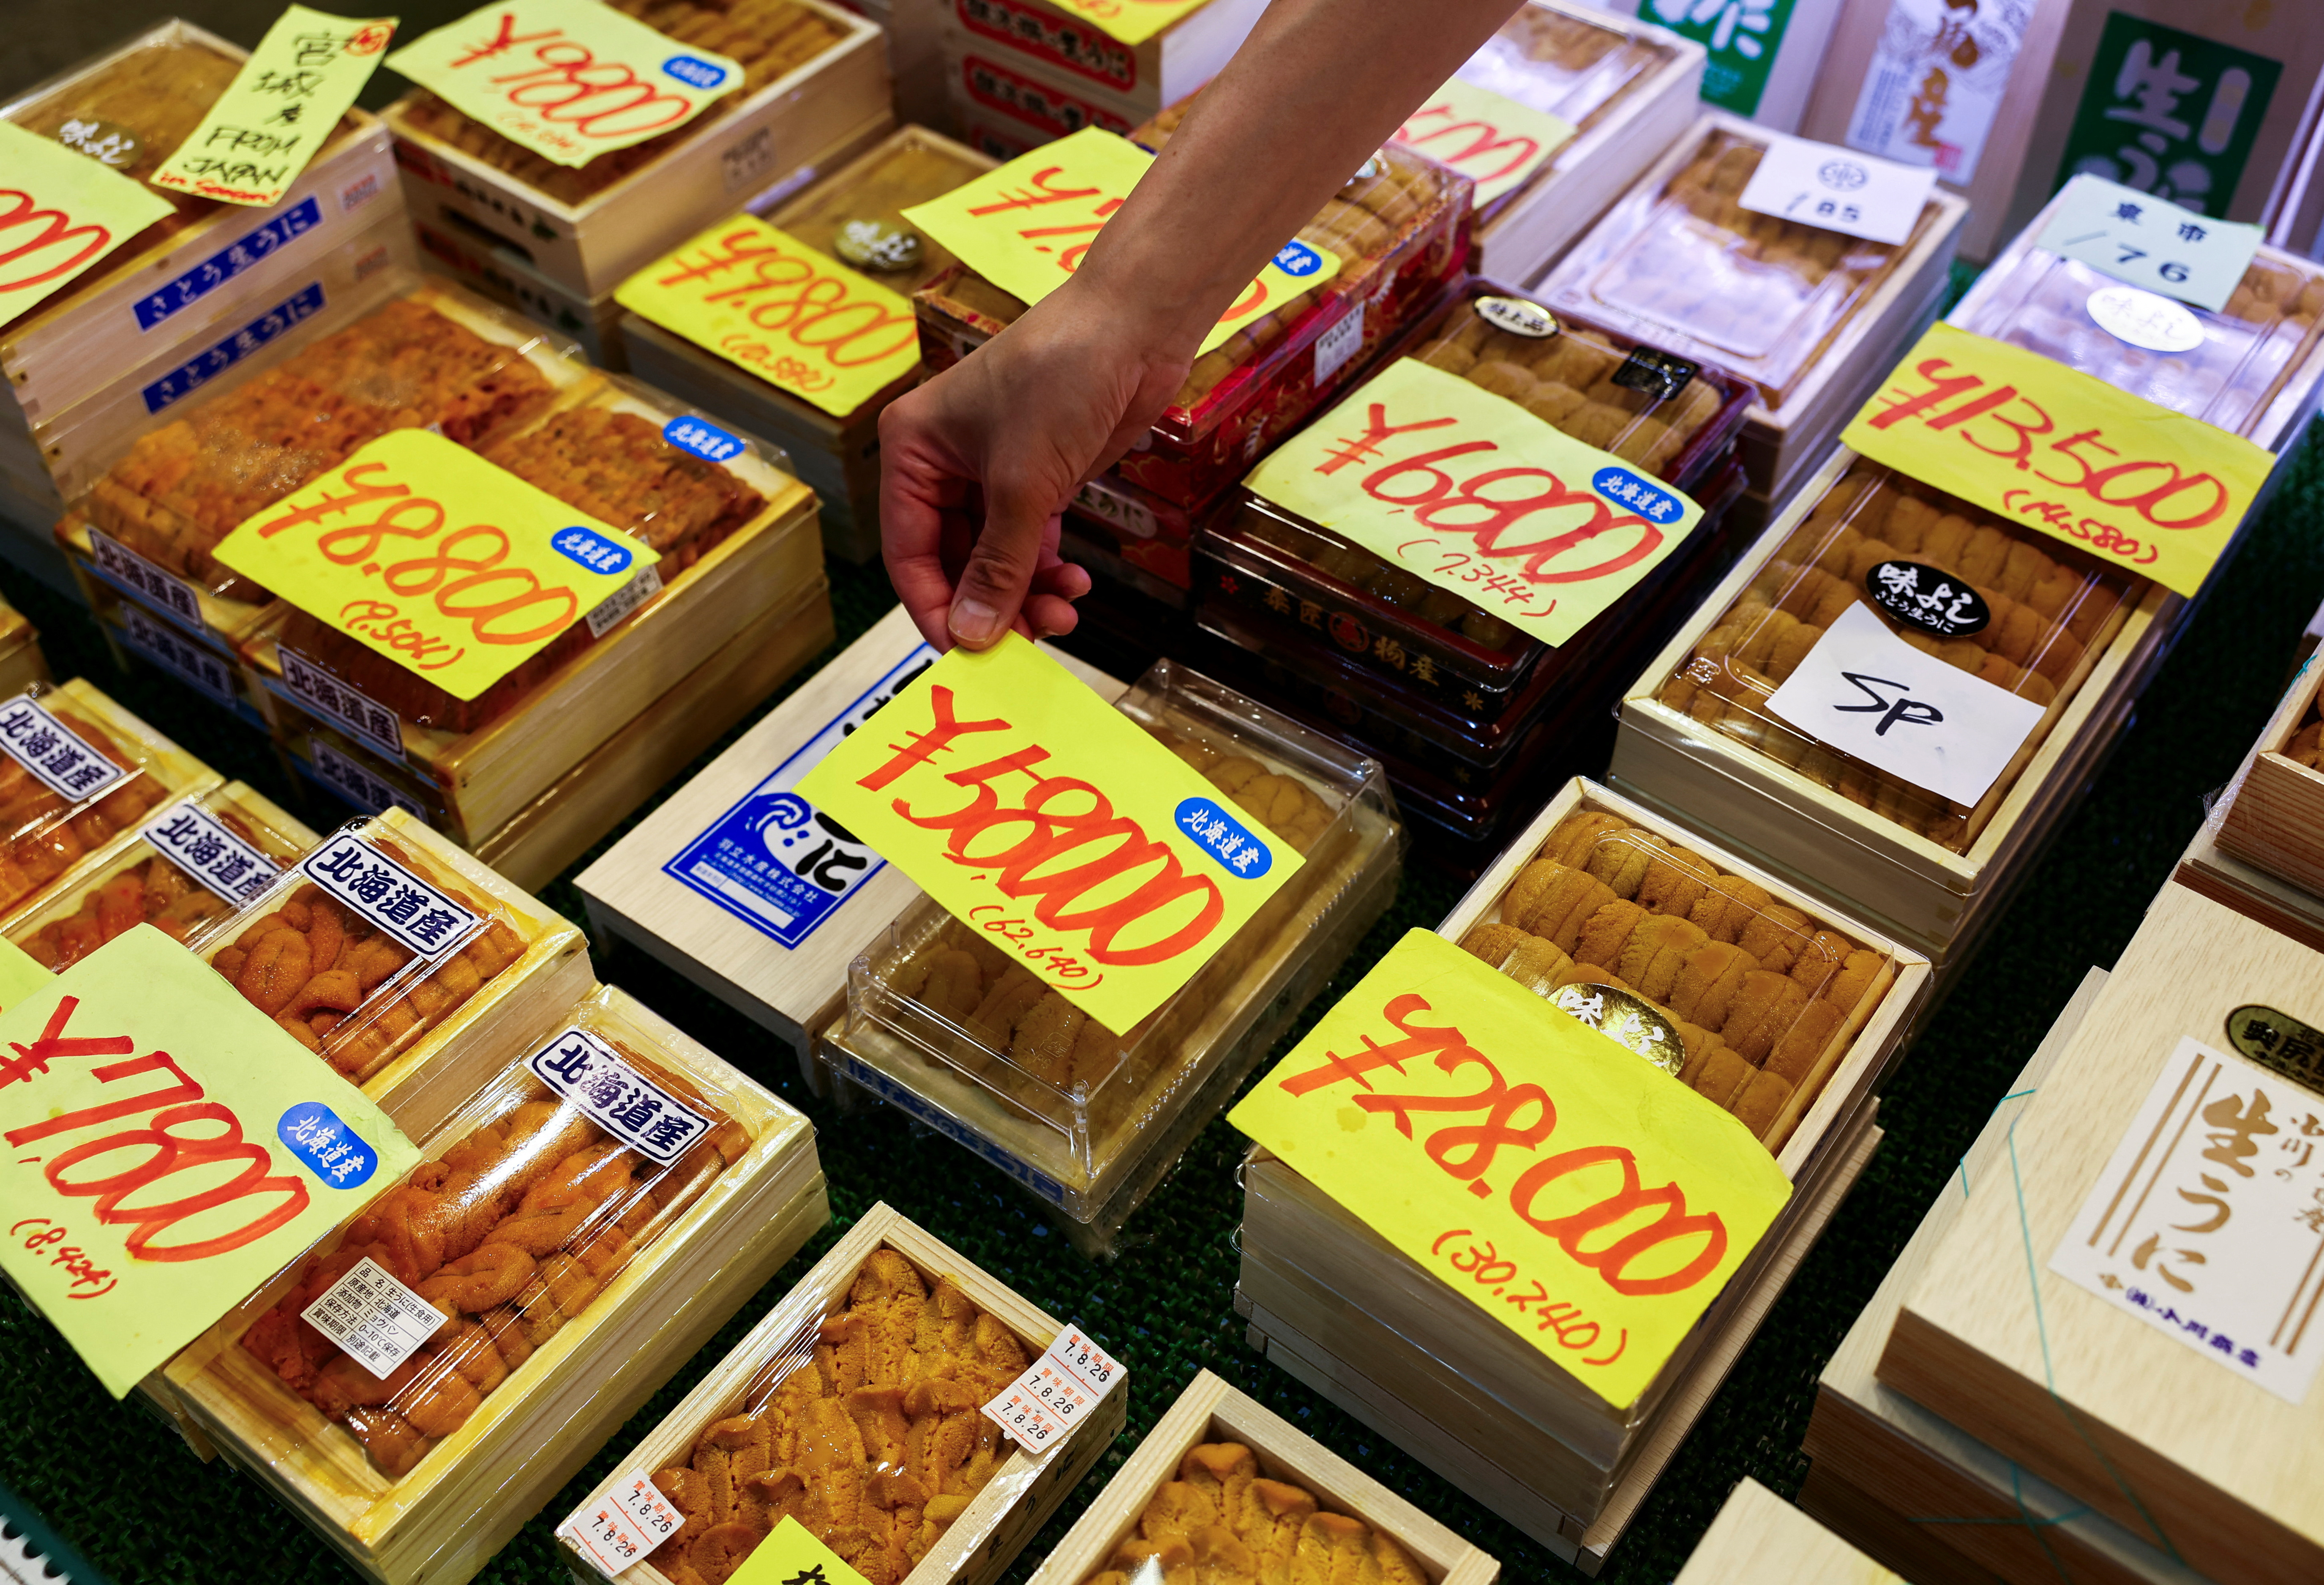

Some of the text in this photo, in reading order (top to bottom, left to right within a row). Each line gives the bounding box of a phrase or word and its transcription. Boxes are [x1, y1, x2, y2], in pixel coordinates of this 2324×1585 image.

[205, 126, 302, 158] FROM
[182, 156, 290, 185] JAPAN
[151, 206, 310, 320] さとう生うに
[160, 291, 314, 402] さとう生うに
[669, 423, 734, 461] 北海道産
[1868, 358, 2229, 529] ¥13.500
[1599, 475, 1672, 520] 北海道産
[257, 462, 578, 645] ¥8.800
[558, 532, 622, 571] 北海道産
[1875, 589, 1957, 634] さとう生うに
[1879, 563, 1980, 624] 味よし
[288, 661, 397, 752] 北海道産
[1833, 671, 1944, 736] SP
[1, 710, 108, 792] 北海道産
[1182, 807, 1261, 874] 北海道産
[317, 846, 463, 947] 北海道産
[544, 1045, 696, 1153] 北海道産
[286, 1114, 365, 1183] 北海道産
[1279, 993, 1728, 1296] ¥28.000
[2131, 1087, 2279, 1294] 生うに
[324, 1298, 358, 1326] 保存方法
[336, 1287, 399, 1336] 添加物 ミョウバン
[347, 1277, 401, 1320] 原産地 北海道
[385, 1287, 436, 1327] 生うに(生食用)
[312, 1307, 381, 1363] 賞味期限 別途記載
[1070, 1333, 1115, 1375] 賞味期限
[1064, 1341, 1111, 1384] 7.8.26
[1028, 1374, 1075, 1416] 7.8.26
[1041, 1366, 1085, 1407] 賞味期限
[1001, 1401, 1049, 1441] 7.8.26
[1009, 1394, 1055, 1435] 賞味期限
[627, 1489, 673, 1534] 7.8.26
[633, 1479, 675, 1524] 賞味期限
[591, 1517, 637, 1559] 7.8.26
[598, 1509, 639, 1553] 賞味期限
